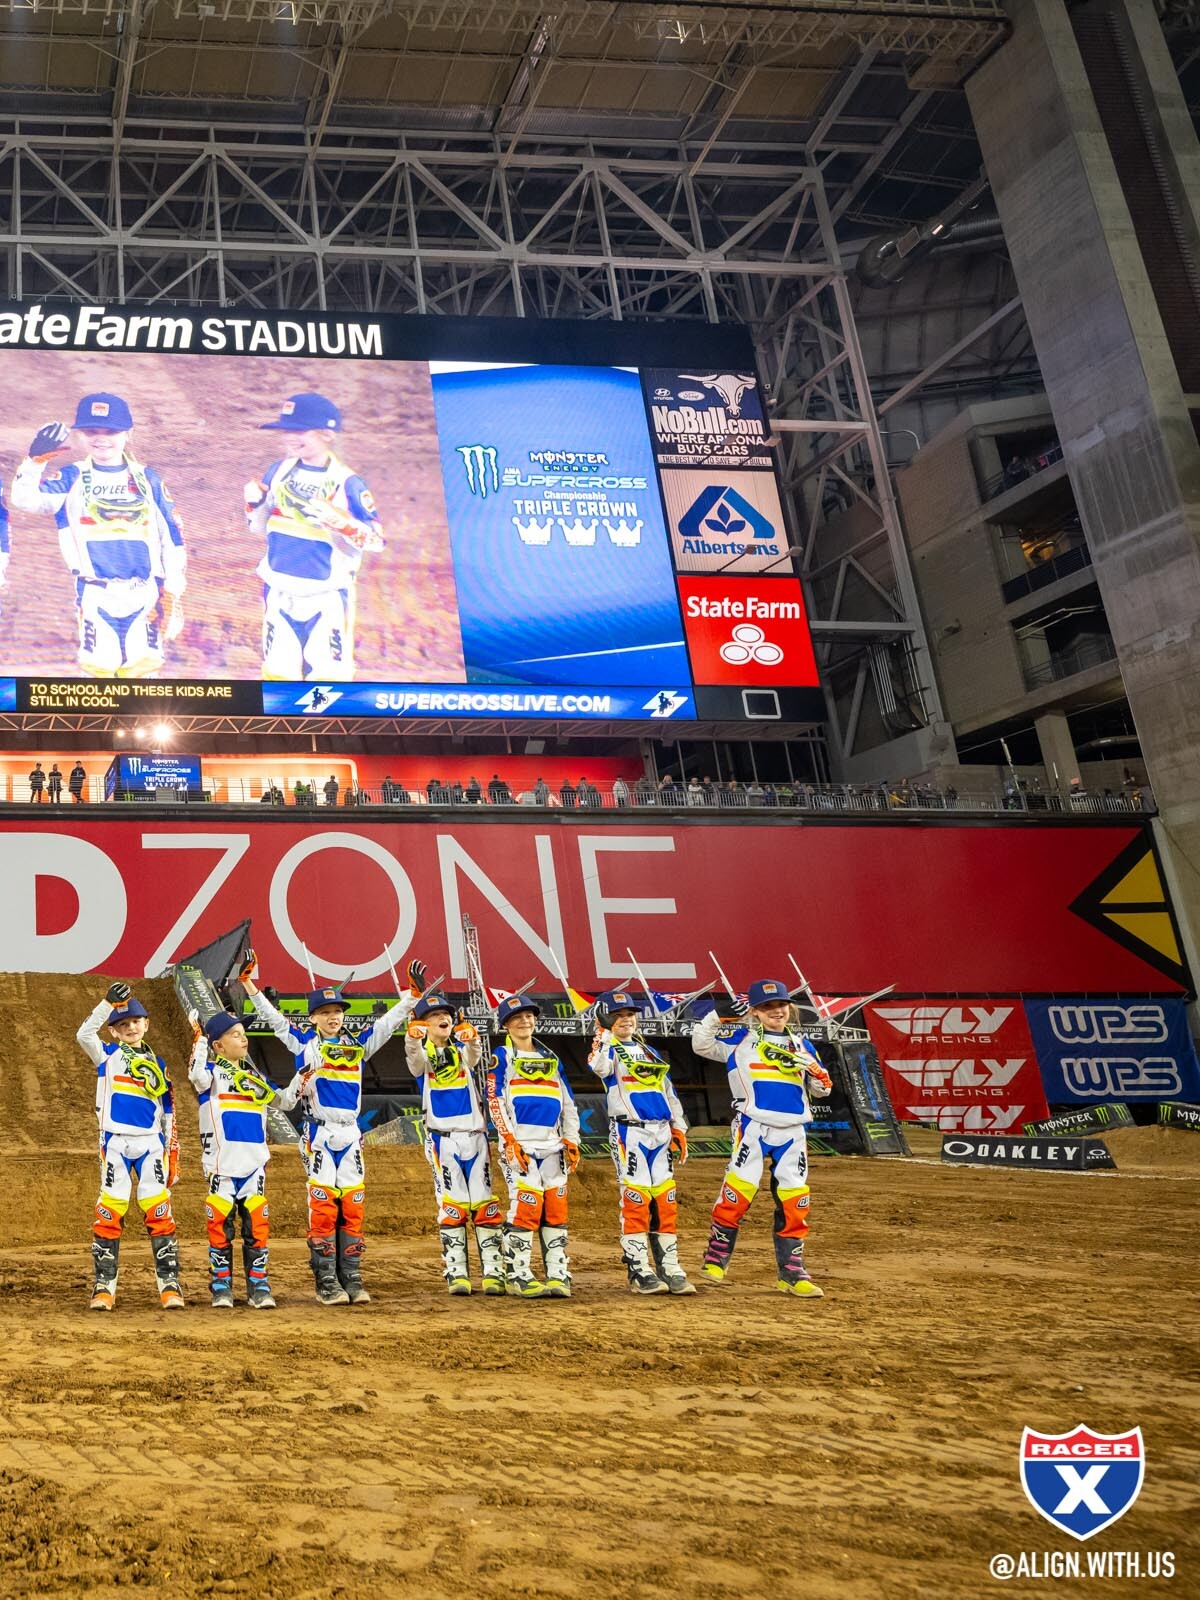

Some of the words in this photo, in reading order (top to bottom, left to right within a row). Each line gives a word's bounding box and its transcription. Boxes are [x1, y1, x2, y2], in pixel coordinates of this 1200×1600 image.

[202, 317, 383, 355] STADIUM
[652, 405, 764, 435] NoBull.com
[657, 433, 705, 444] WHERE
[708, 434, 764, 445] ARONA
[529, 450, 609, 465] MONSTER
[677, 444, 711, 454] BUYS
[714, 445, 749, 456] CARS
[662, 455, 674, 463] THE
[675, 456, 690, 464] BEST
[717, 457, 731, 465] SAVE
[109, 485, 127, 495] LEE
[502, 474, 648, 489] SUPERCROSS
[543, 490, 607, 502] Championship
[513, 500, 572, 516] TRIPLE
[576, 501, 638, 517] CROWN
[682, 539, 780, 556] Albertsns
[30, 684, 47, 695] TO
[50, 684, 103, 696] SCHOOL
[103, 685, 130, 696] AND
[132, 686, 173, 697] THESE
[176, 686, 205, 697] KIDS
[206, 687, 232, 698] ARE
[30, 695, 63, 707] STILL
[66, 696, 78, 707] IN
[81, 696, 120, 707] COOL.
[375, 692, 611, 713] SUPERCROSSLIVE.COM
[1048, 1005, 1169, 1044] WPS
[910, 1036, 992, 1044] RACING
[614, 1042, 635, 1068] 100%
[1060, 1056, 1182, 1096] WPS
[922, 1089, 1004, 1097] RACING
[1038, 1111, 1094, 1133] MONSTER
[1050, 1123, 1088, 1137] ENERGY
[735, 1142, 750, 1168] KTM
[977, 1144, 1078, 1161] OAKLEY
[154, 1158, 165, 1185] KTM
[627, 1151, 638, 1177] KTM
[105, 1161, 115, 1188] KTM
[441, 1164, 452, 1192] KTM
